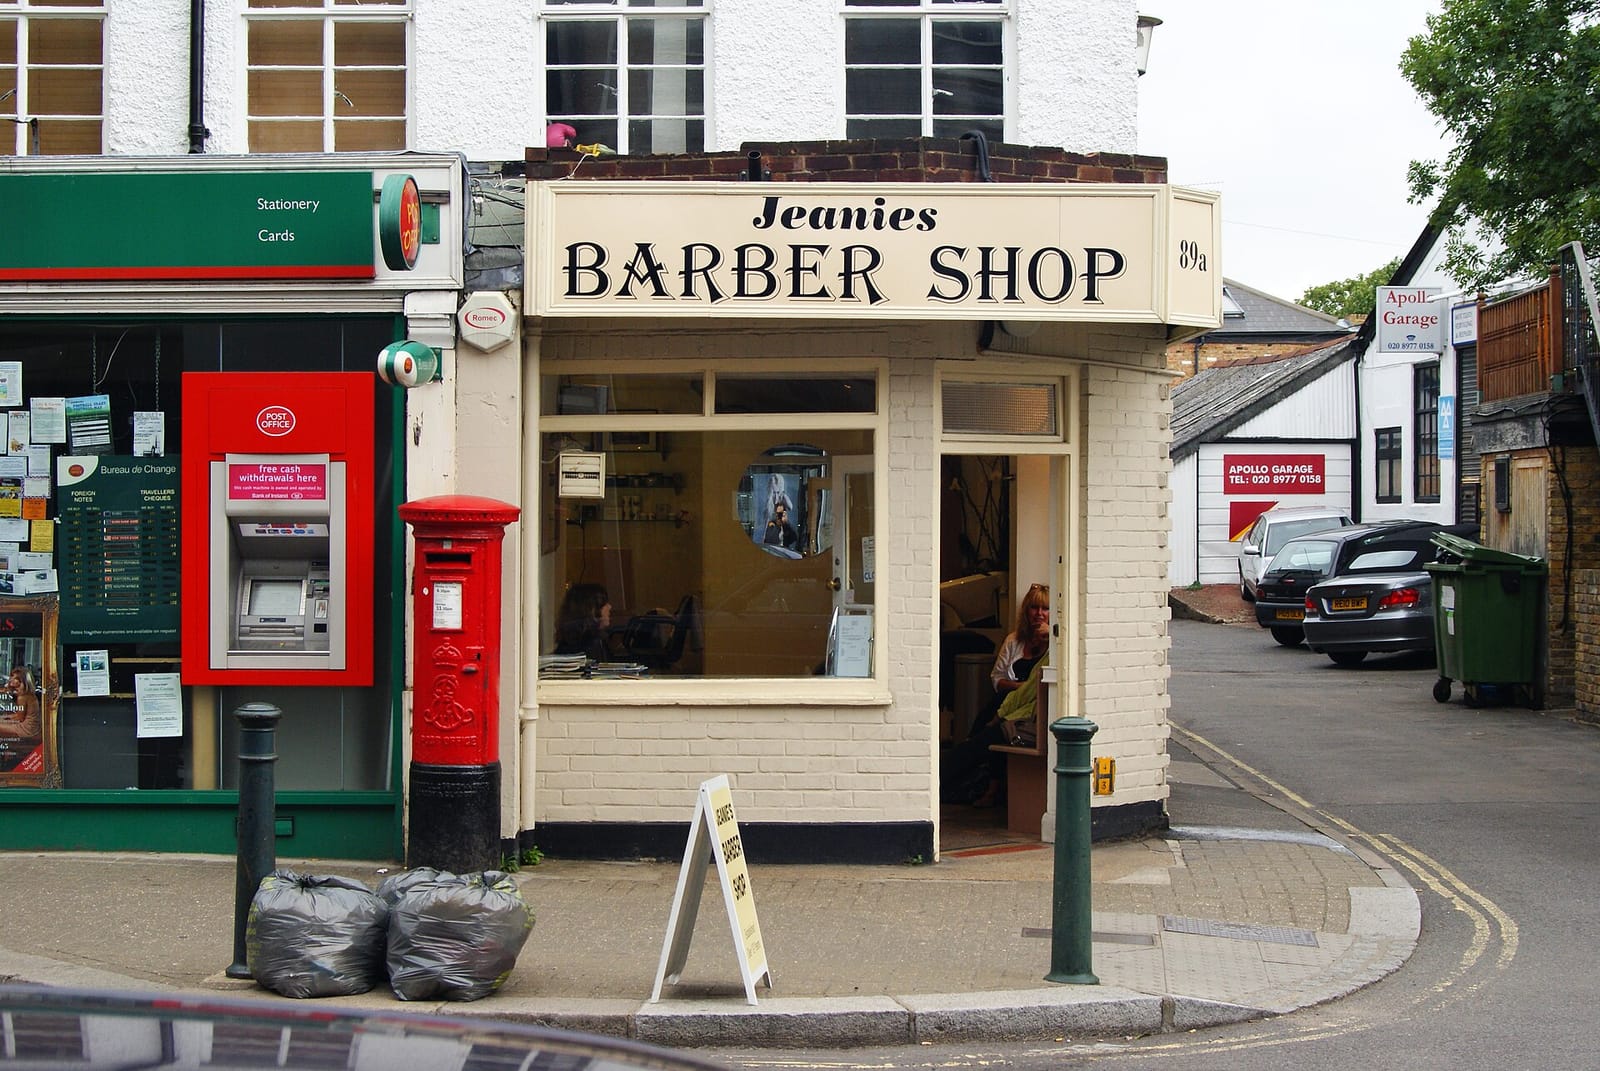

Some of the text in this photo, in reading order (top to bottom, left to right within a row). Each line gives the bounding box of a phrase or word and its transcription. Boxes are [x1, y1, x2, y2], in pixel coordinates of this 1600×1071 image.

[256, 197, 320, 214] Stationery
[752, 195, 938, 233] Jeanies
[257, 229, 296, 243] Cards
[1179, 239, 1207, 273] 89a
[562, 241, 1127, 305] BARBER SHOP
[472, 312, 498, 323] Romec
[1383, 311, 1438, 330] Garage
[1388, 342, 1434, 350] 020 8977 0158
[266, 413, 287, 421] POST
[100, 465, 176, 475] Bureau de Change
[259, 464, 301, 474] free cash
[1229, 463, 1313, 474] APOLLO GARAGE
[239, 472, 318, 483] withdrawals here
[1229, 474, 1322, 485] TEL: 020 8977 0158
